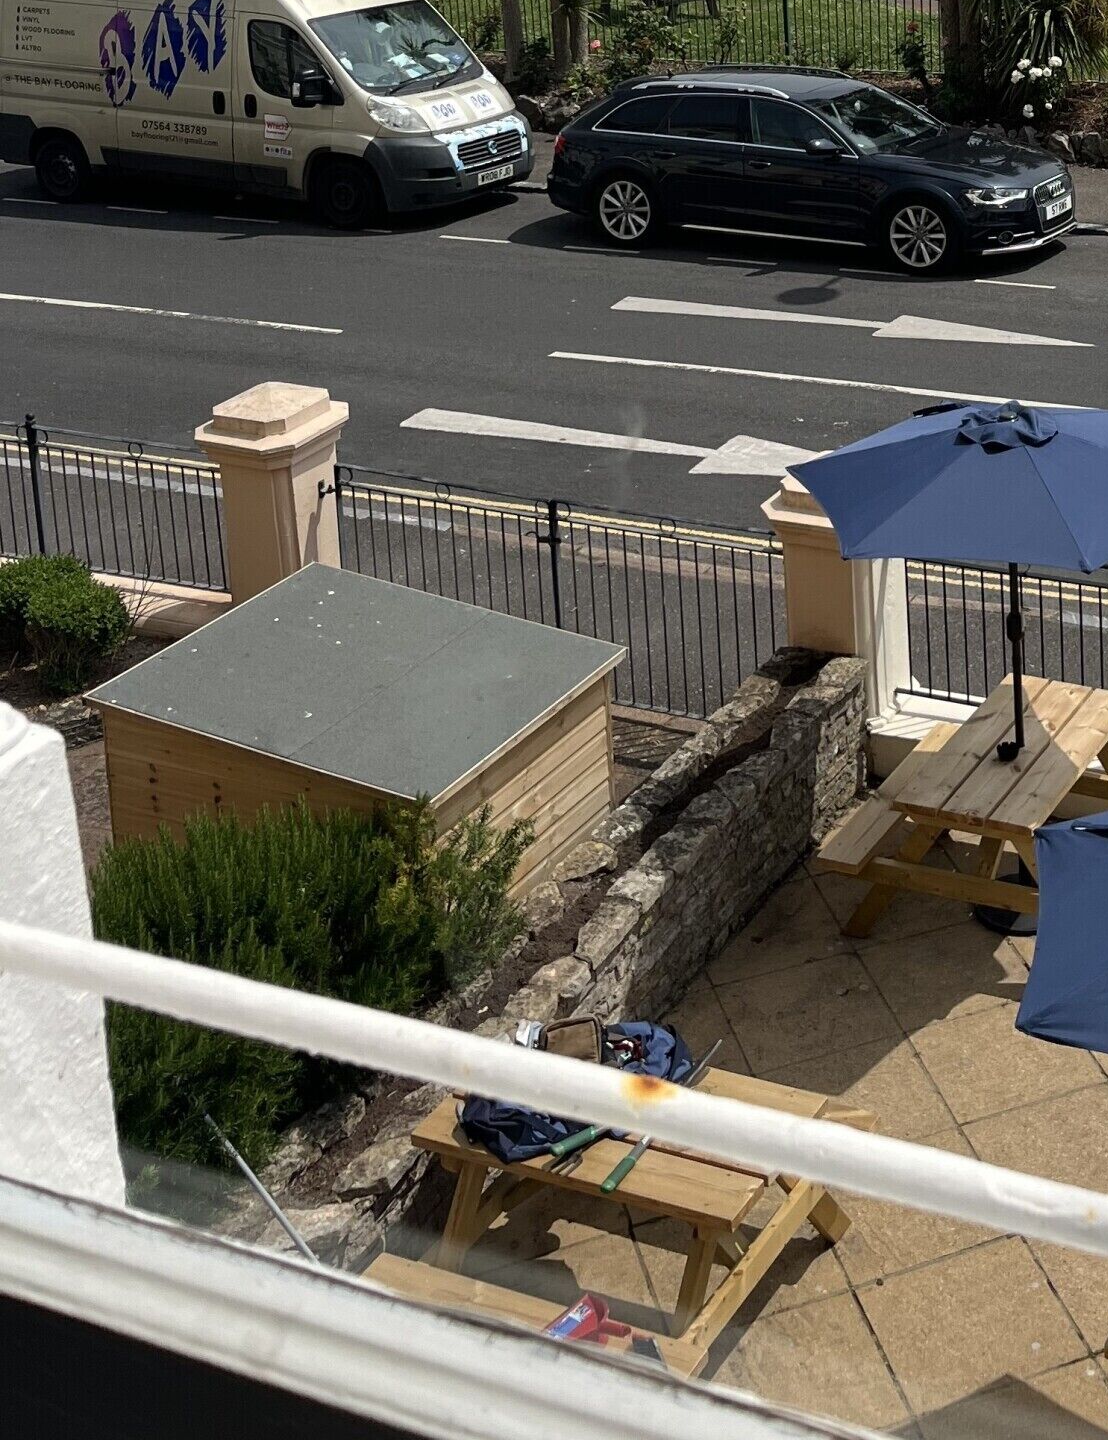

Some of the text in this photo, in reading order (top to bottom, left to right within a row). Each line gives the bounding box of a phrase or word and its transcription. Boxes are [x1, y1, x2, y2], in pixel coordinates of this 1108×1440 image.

[22, 6, 51, 15] CARPETS
[22, 16, 41, 24] VINYL
[21, 25, 76, 37] WOOD FLOORING
[14, 75, 101, 93] THE BAY FLOORING
[141, 119, 171, 131] 07564
